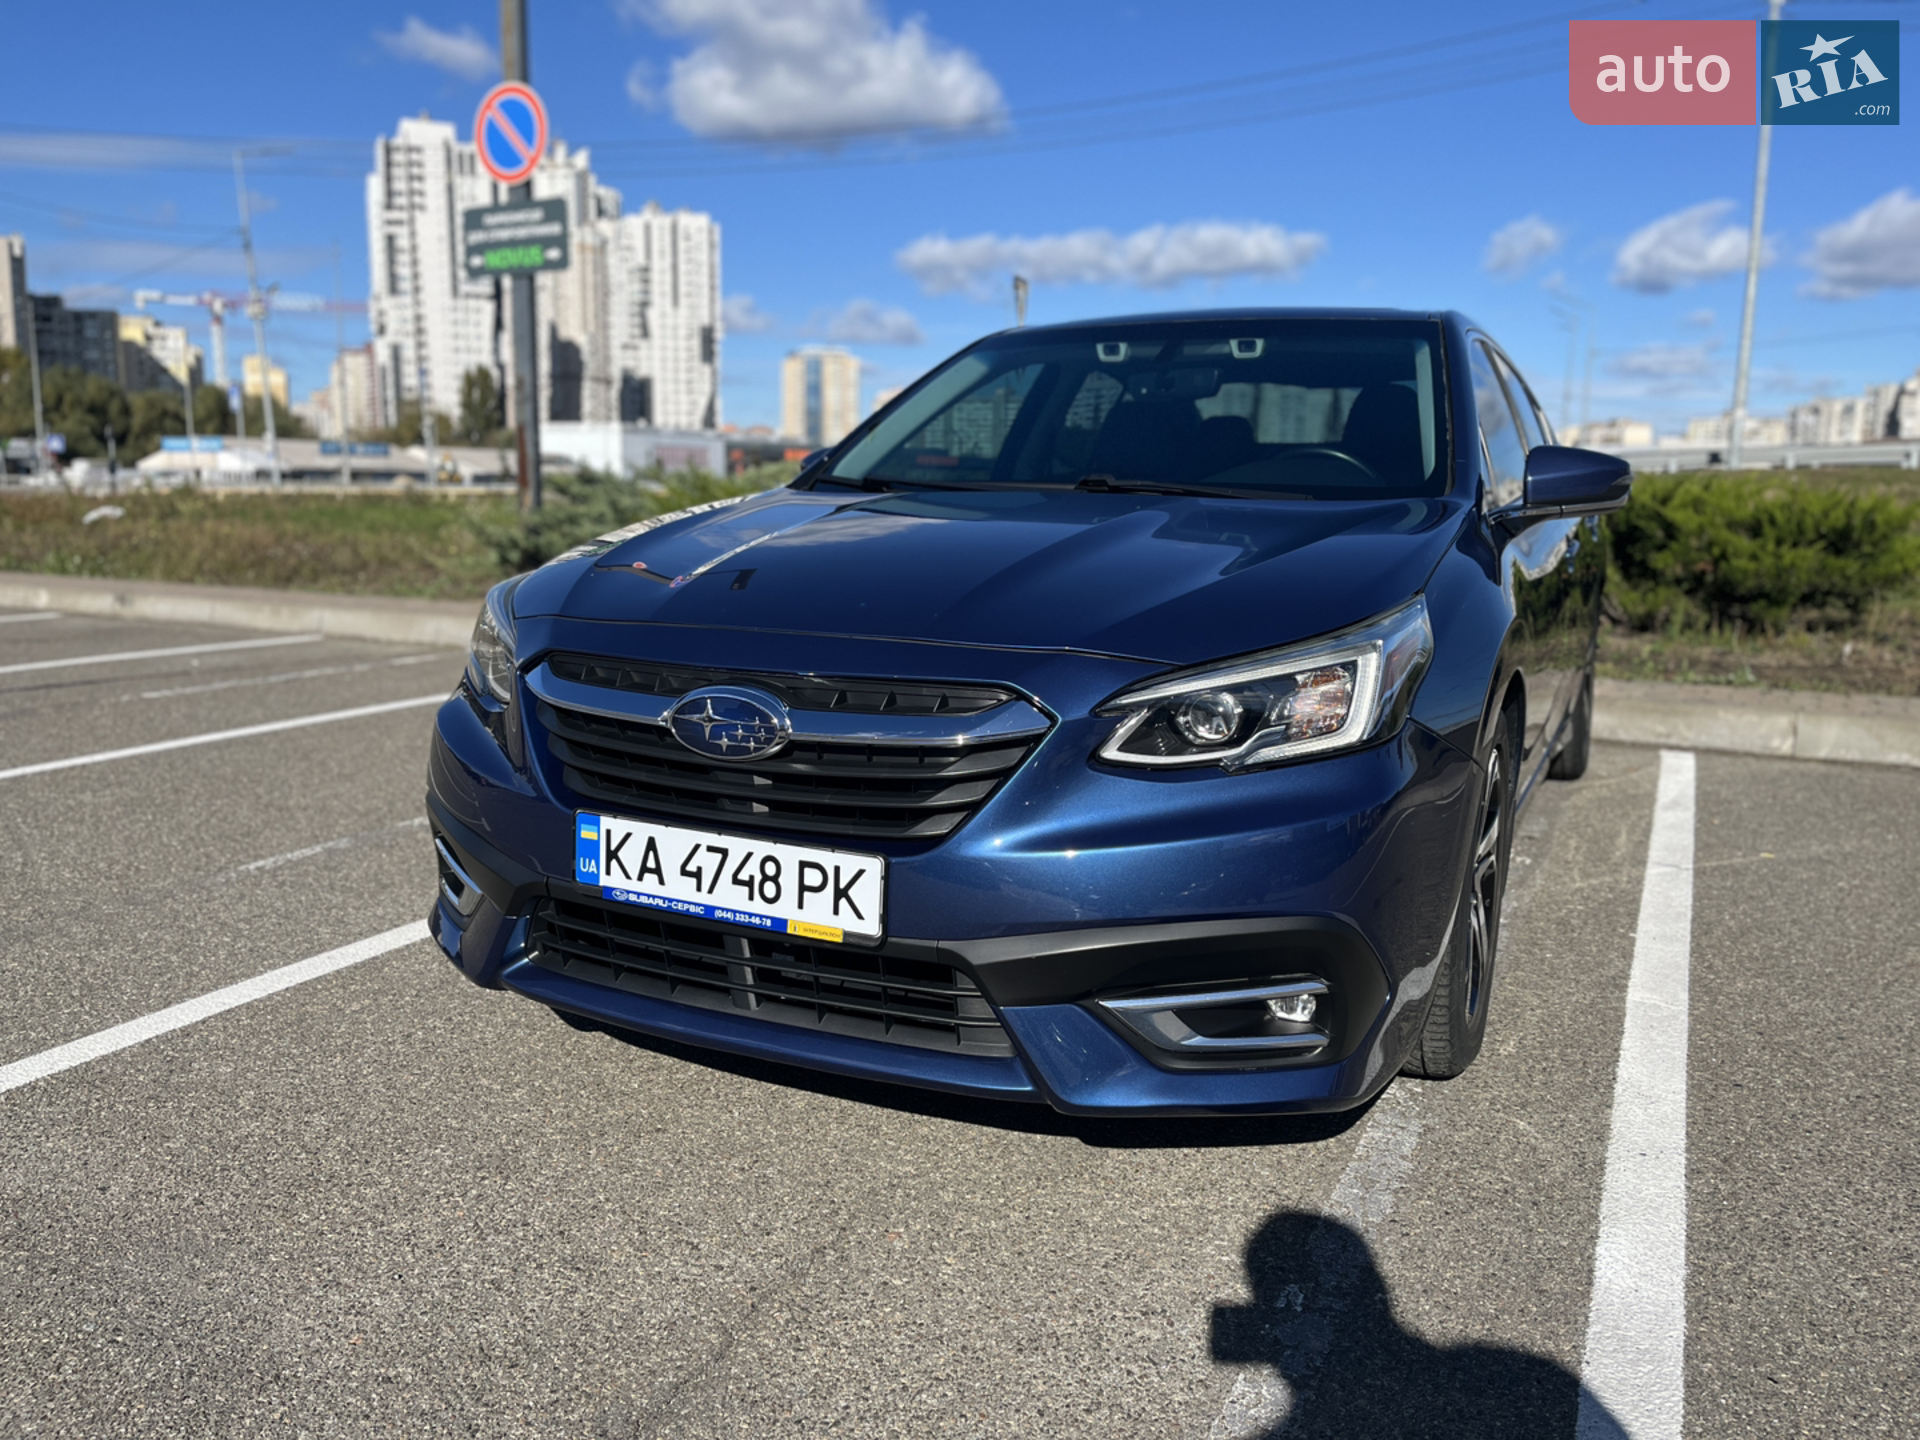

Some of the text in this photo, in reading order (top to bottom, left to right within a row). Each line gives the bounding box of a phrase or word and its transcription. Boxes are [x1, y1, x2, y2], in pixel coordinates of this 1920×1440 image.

[580, 856, 598, 874] UA
[605, 828, 867, 920] KA 4748 PK
